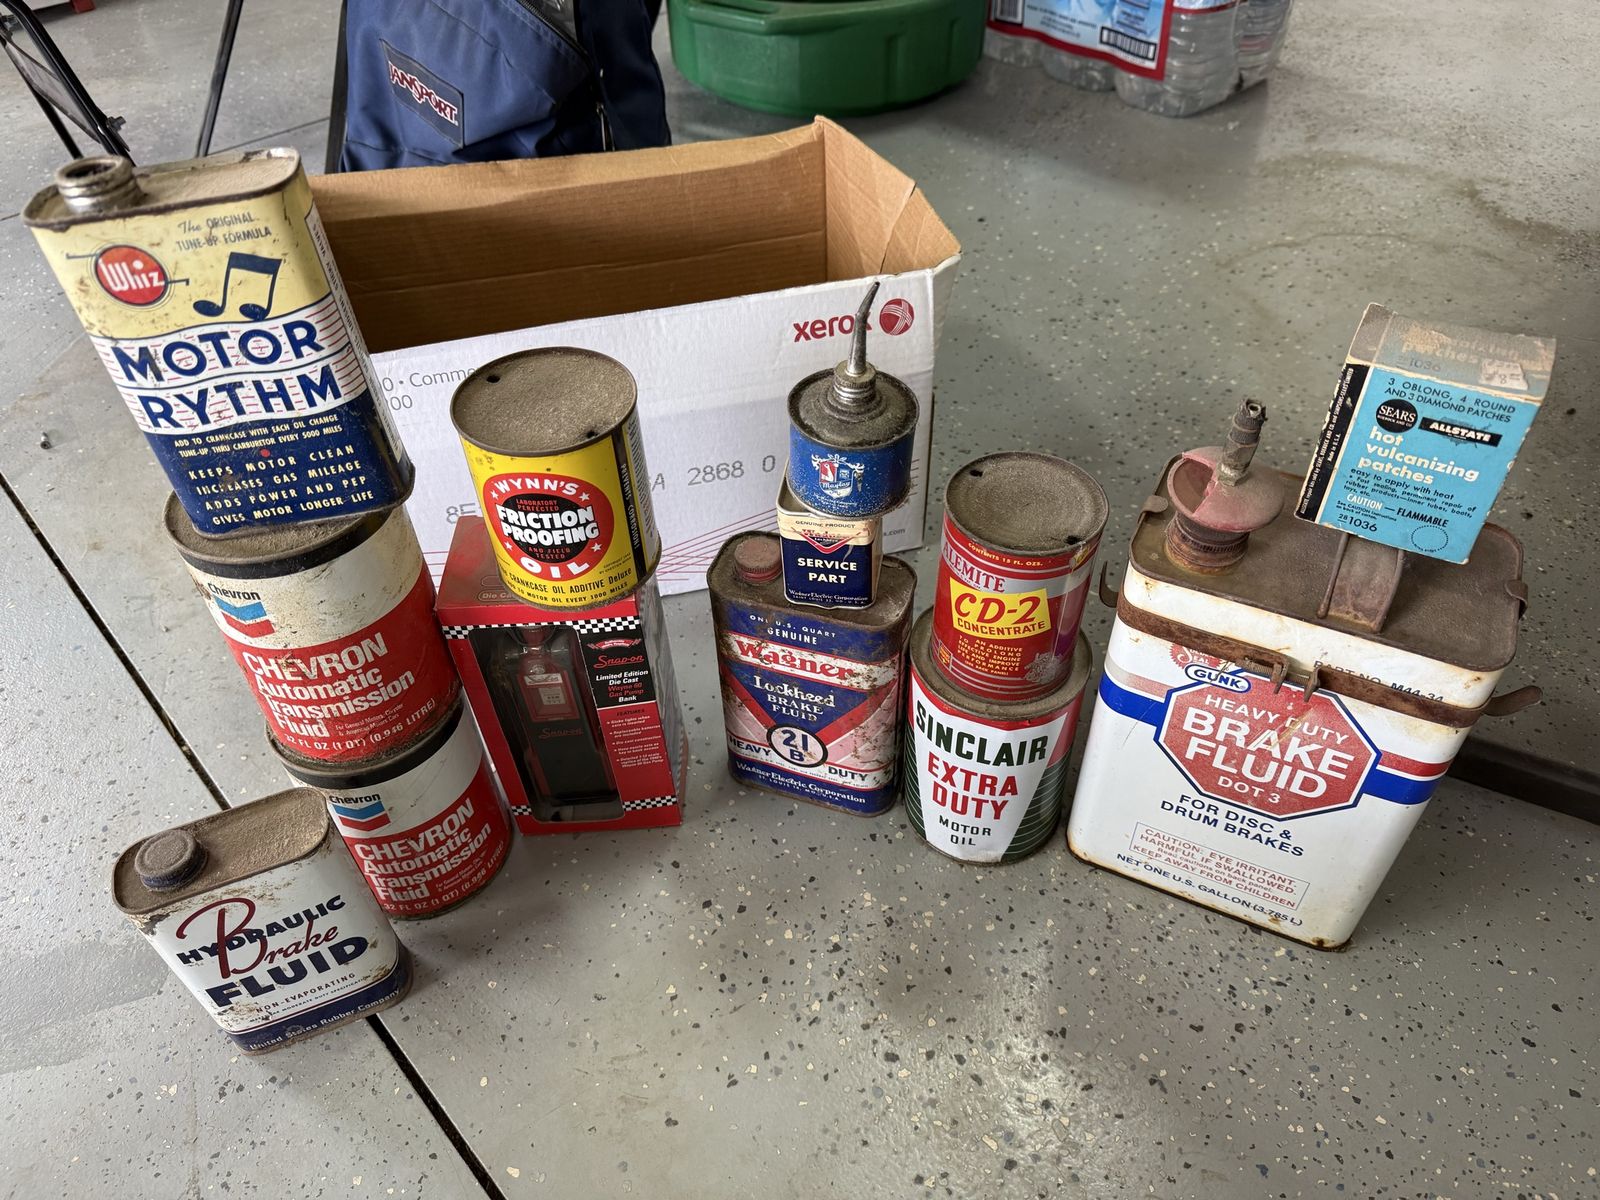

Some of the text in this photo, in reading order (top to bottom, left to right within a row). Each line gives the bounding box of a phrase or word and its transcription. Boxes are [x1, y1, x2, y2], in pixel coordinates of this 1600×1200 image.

[176, 227, 272, 251] TUNE-UP FORMULA
[177, 212, 254, 234] The ORIGINAL
[98, 258, 165, 291] Whiz
[111, 320, 325, 382] MOTOR
[138, 364, 343, 428] RYTHM
[1385, 387, 1512, 423] AND 3 DIAMOND PATCHES
[1388, 378, 1516, 414] 3 OBLONG, 4 ROUND
[1379, 405, 1416, 423] SEARS
[174, 414, 338, 448] ADD TO CRANKCASE WITH EACH OIL CHANGE
[179, 425, 343, 458] TUNE-UP THRU CARBURETOR EVERY 5000 MILES
[1369, 426, 1403, 446] hot
[1429, 422, 1492, 442] ALLSTATE
[189, 445, 355, 480] KEEPS MOTOR CLEAN
[687, 461, 744, 486] 2868
[1358, 457, 1434, 484] patches
[1366, 443, 1480, 482] vulcanizing
[206, 476, 367, 511] ADDS POWER AND PEP
[494, 478, 579, 495] WYNN'S
[621, 463, 631, 500] PREVENTS
[1350, 468, 1454, 500] easy to apply with heat
[212, 491, 374, 525] GIVES MOTOR LONGER LIFE
[496, 505, 595, 529] FRICTION
[1347, 493, 1449, 528] CAUTION FLAMMABLE
[501, 522, 600, 546] PROOFING
[509, 567, 632, 595] CRANKCASE OIL ADDITIVE Deluxe
[520, 556, 590, 579] OIL
[797, 558, 857, 571] SERVICE
[808, 572, 847, 584] PART
[943, 542, 1005, 593] ALEMITE
[207, 582, 261, 600] Chevron
[954, 592, 1041, 625] CD-2
[767, 627, 817, 645] GENUINE
[957, 618, 1045, 636] CONCENTRATE
[242, 632, 388, 682] CHEVRON
[593, 655, 644, 668] Snap-on
[735, 640, 854, 680] Wagner
[957, 650, 1019, 671] PERFORMANCE
[958, 640, 989, 657] EFFECTIVE
[989, 644, 1023, 652] ADDITIVE
[255, 667, 383, 700] Automatic
[596, 672, 622, 681] Limited
[754, 676, 835, 707] Lockheed
[1193, 669, 1242, 689] GUNK
[260, 669, 416, 720] Transmission
[618, 695, 637, 703] Bank
[767, 695, 824, 715] BRAKE
[274, 713, 330, 738] Fluid
[772, 705, 817, 722] FLUID
[1205, 694, 1349, 745] HEAVY DUTY
[781, 730, 808, 751] 21
[916, 700, 1048, 767] SINCLAIR
[1183, 706, 1355, 780] BRAKE
[729, 736, 772, 756] HEAVY
[828, 766, 868, 782] DUTY
[790, 749, 804, 762] B
[1185, 736, 1327, 798] FLUID
[736, 761, 771, 779] Wagner
[771, 772, 808, 789] Electric
[808, 783, 866, 804] Corporation
[928, 751, 1018, 797] EXTRA
[1218, 776, 1281, 804] DOT 3
[329, 793, 381, 804] Chevron
[932, 780, 1009, 820] DUTY
[354, 797, 475, 860] CHEVRON
[939, 815, 992, 836] MOTOR
[1160, 801, 1304, 857] DRUM BRAKES
[1179, 794, 1292, 840] FOR DISC &
[363, 826, 472, 875] Automatic
[364, 823, 492, 888] Transmission
[950, 834, 976, 846] OIL
[1133, 845, 1296, 908] KEEP AWAY FROM CHILDREN
[1140, 834, 1198, 859] HARMFUL
[1215, 861, 1296, 895] SWALLOWED.
[375, 884, 430, 901] Fluid
[1117, 853, 1303, 926] NET ONE U.S. GALLON (3.785 L)
[176, 895, 346, 964] HYDRAULIC
[176, 897, 338, 979] Brake
[205, 936, 369, 1008] FLUID
[256, 972, 356, 1013] NON-EVAPORATING
[250, 989, 400, 1050] United States Rubber Company
